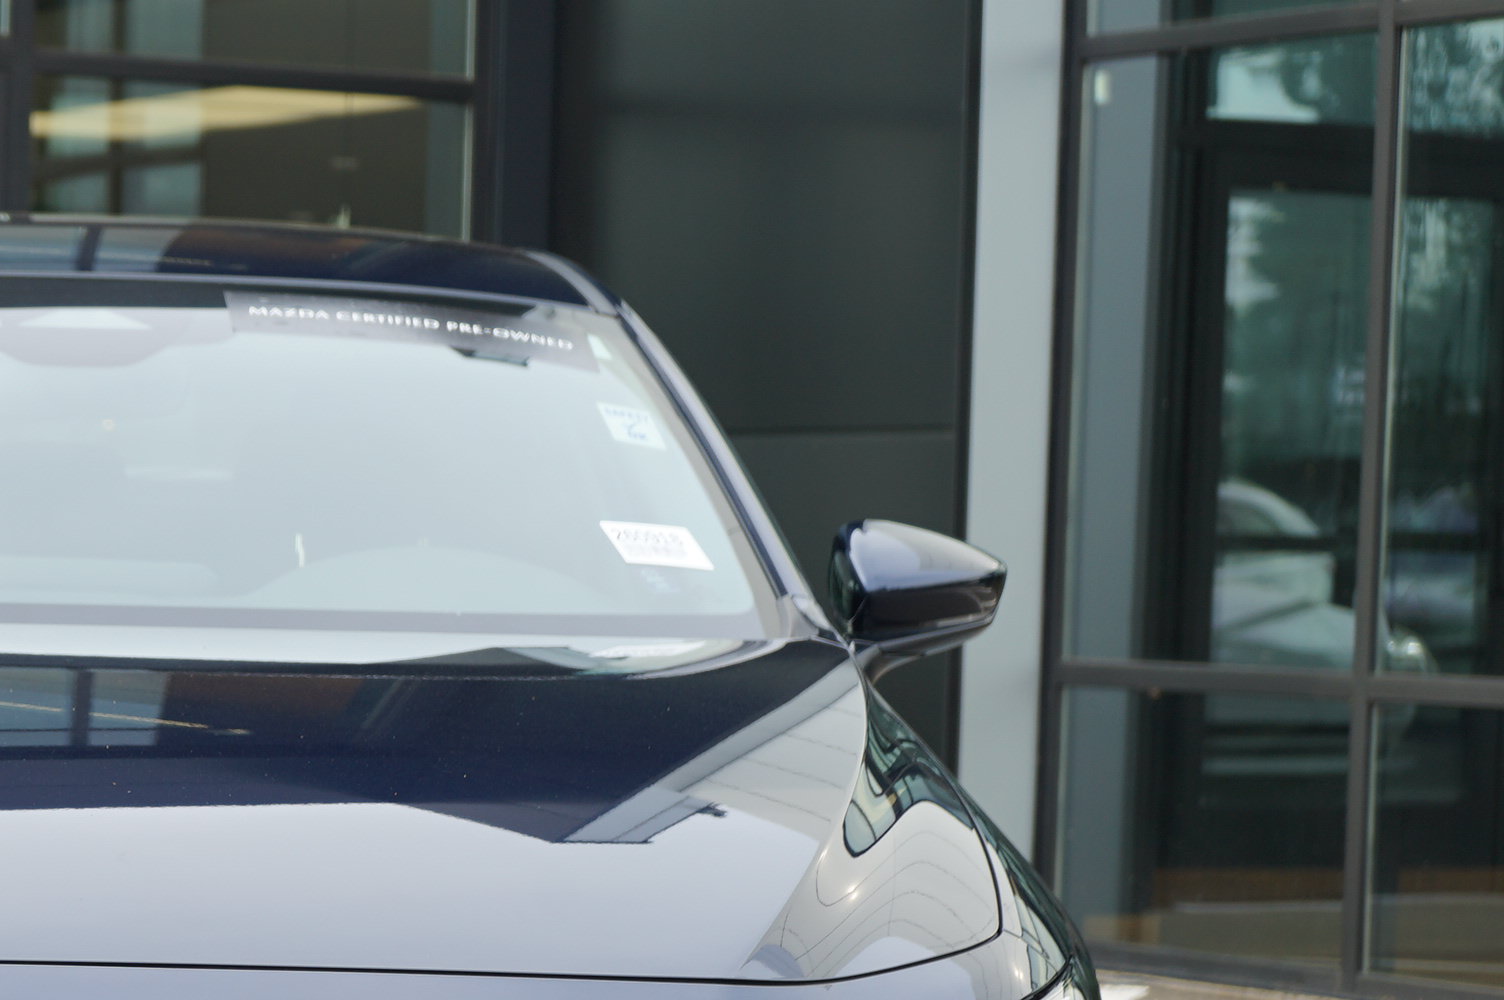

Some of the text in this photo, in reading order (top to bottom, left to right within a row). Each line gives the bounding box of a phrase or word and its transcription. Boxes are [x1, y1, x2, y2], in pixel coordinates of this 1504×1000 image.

[249, 306, 574, 350] MAZDA CERTIFIED PRE-OWNED
